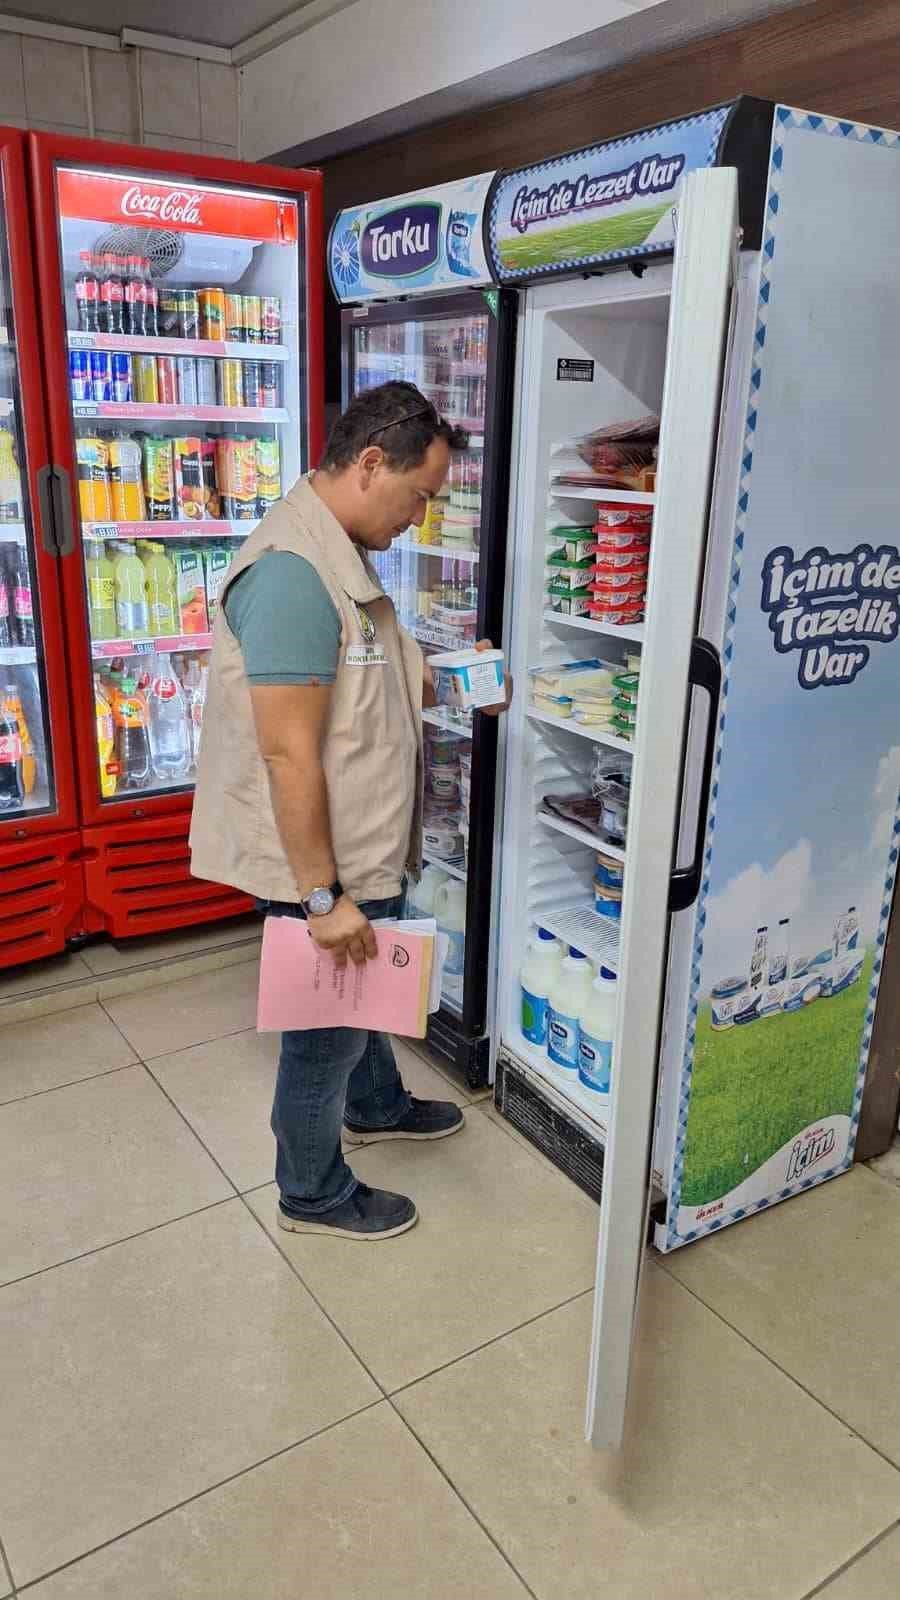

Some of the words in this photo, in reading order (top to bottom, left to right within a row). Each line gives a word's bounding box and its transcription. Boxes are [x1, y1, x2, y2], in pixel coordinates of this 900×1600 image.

[119, 186, 204, 225] Coca-Cola
[512, 186, 572, 233] İçim'de
[575, 173, 634, 207] Lezzet
[639, 159, 680, 189] Var
[368, 217, 431, 263] Torku
[769, 554, 900, 607] İçim'de
[776, 598, 897, 645] Tazelik
[804, 645, 864, 683] Var
